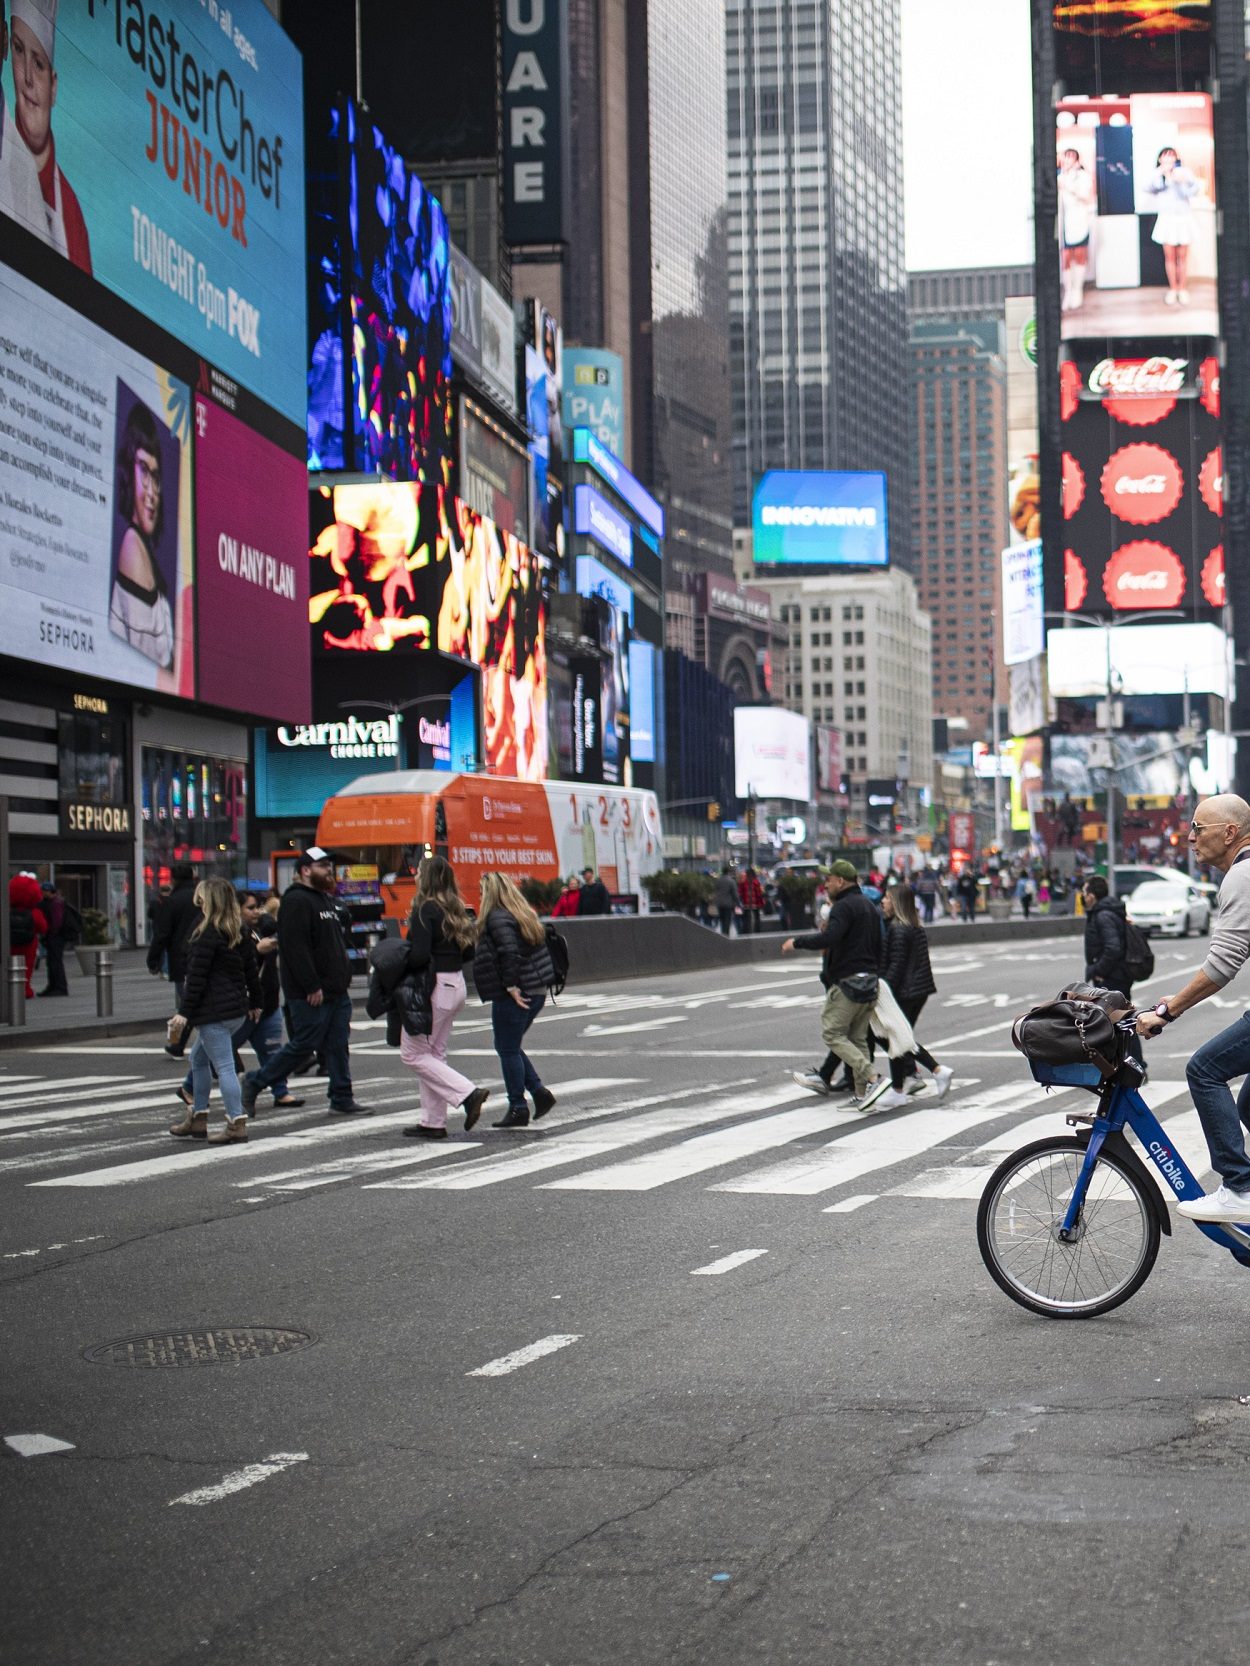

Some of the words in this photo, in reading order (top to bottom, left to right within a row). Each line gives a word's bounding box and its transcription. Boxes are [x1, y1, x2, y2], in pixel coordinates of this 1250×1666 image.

[145, 87, 249, 249] JUNIOR
[131, 204, 195, 305] TONIGHT
[197, 261, 227, 331] 8pm
[227, 286, 262, 359] FOX
[218, 532, 238, 572] ON
[239, 544, 266, 588] ANY
[266, 557, 297, 601] PLAN
[40, 620, 95, 655] SEPHORA
[73, 693, 108, 715] SEPHORA
[69, 803, 129, 834] SEPHORA
[459, 847, 482, 865] STEPS
[482, 849, 494, 865] TO
[494, 850, 517, 865] YOUR
[518, 849, 536, 865] BEST
[1150, 1141, 1169, 1163] citi
[1162, 1159, 1186, 1190] bike
